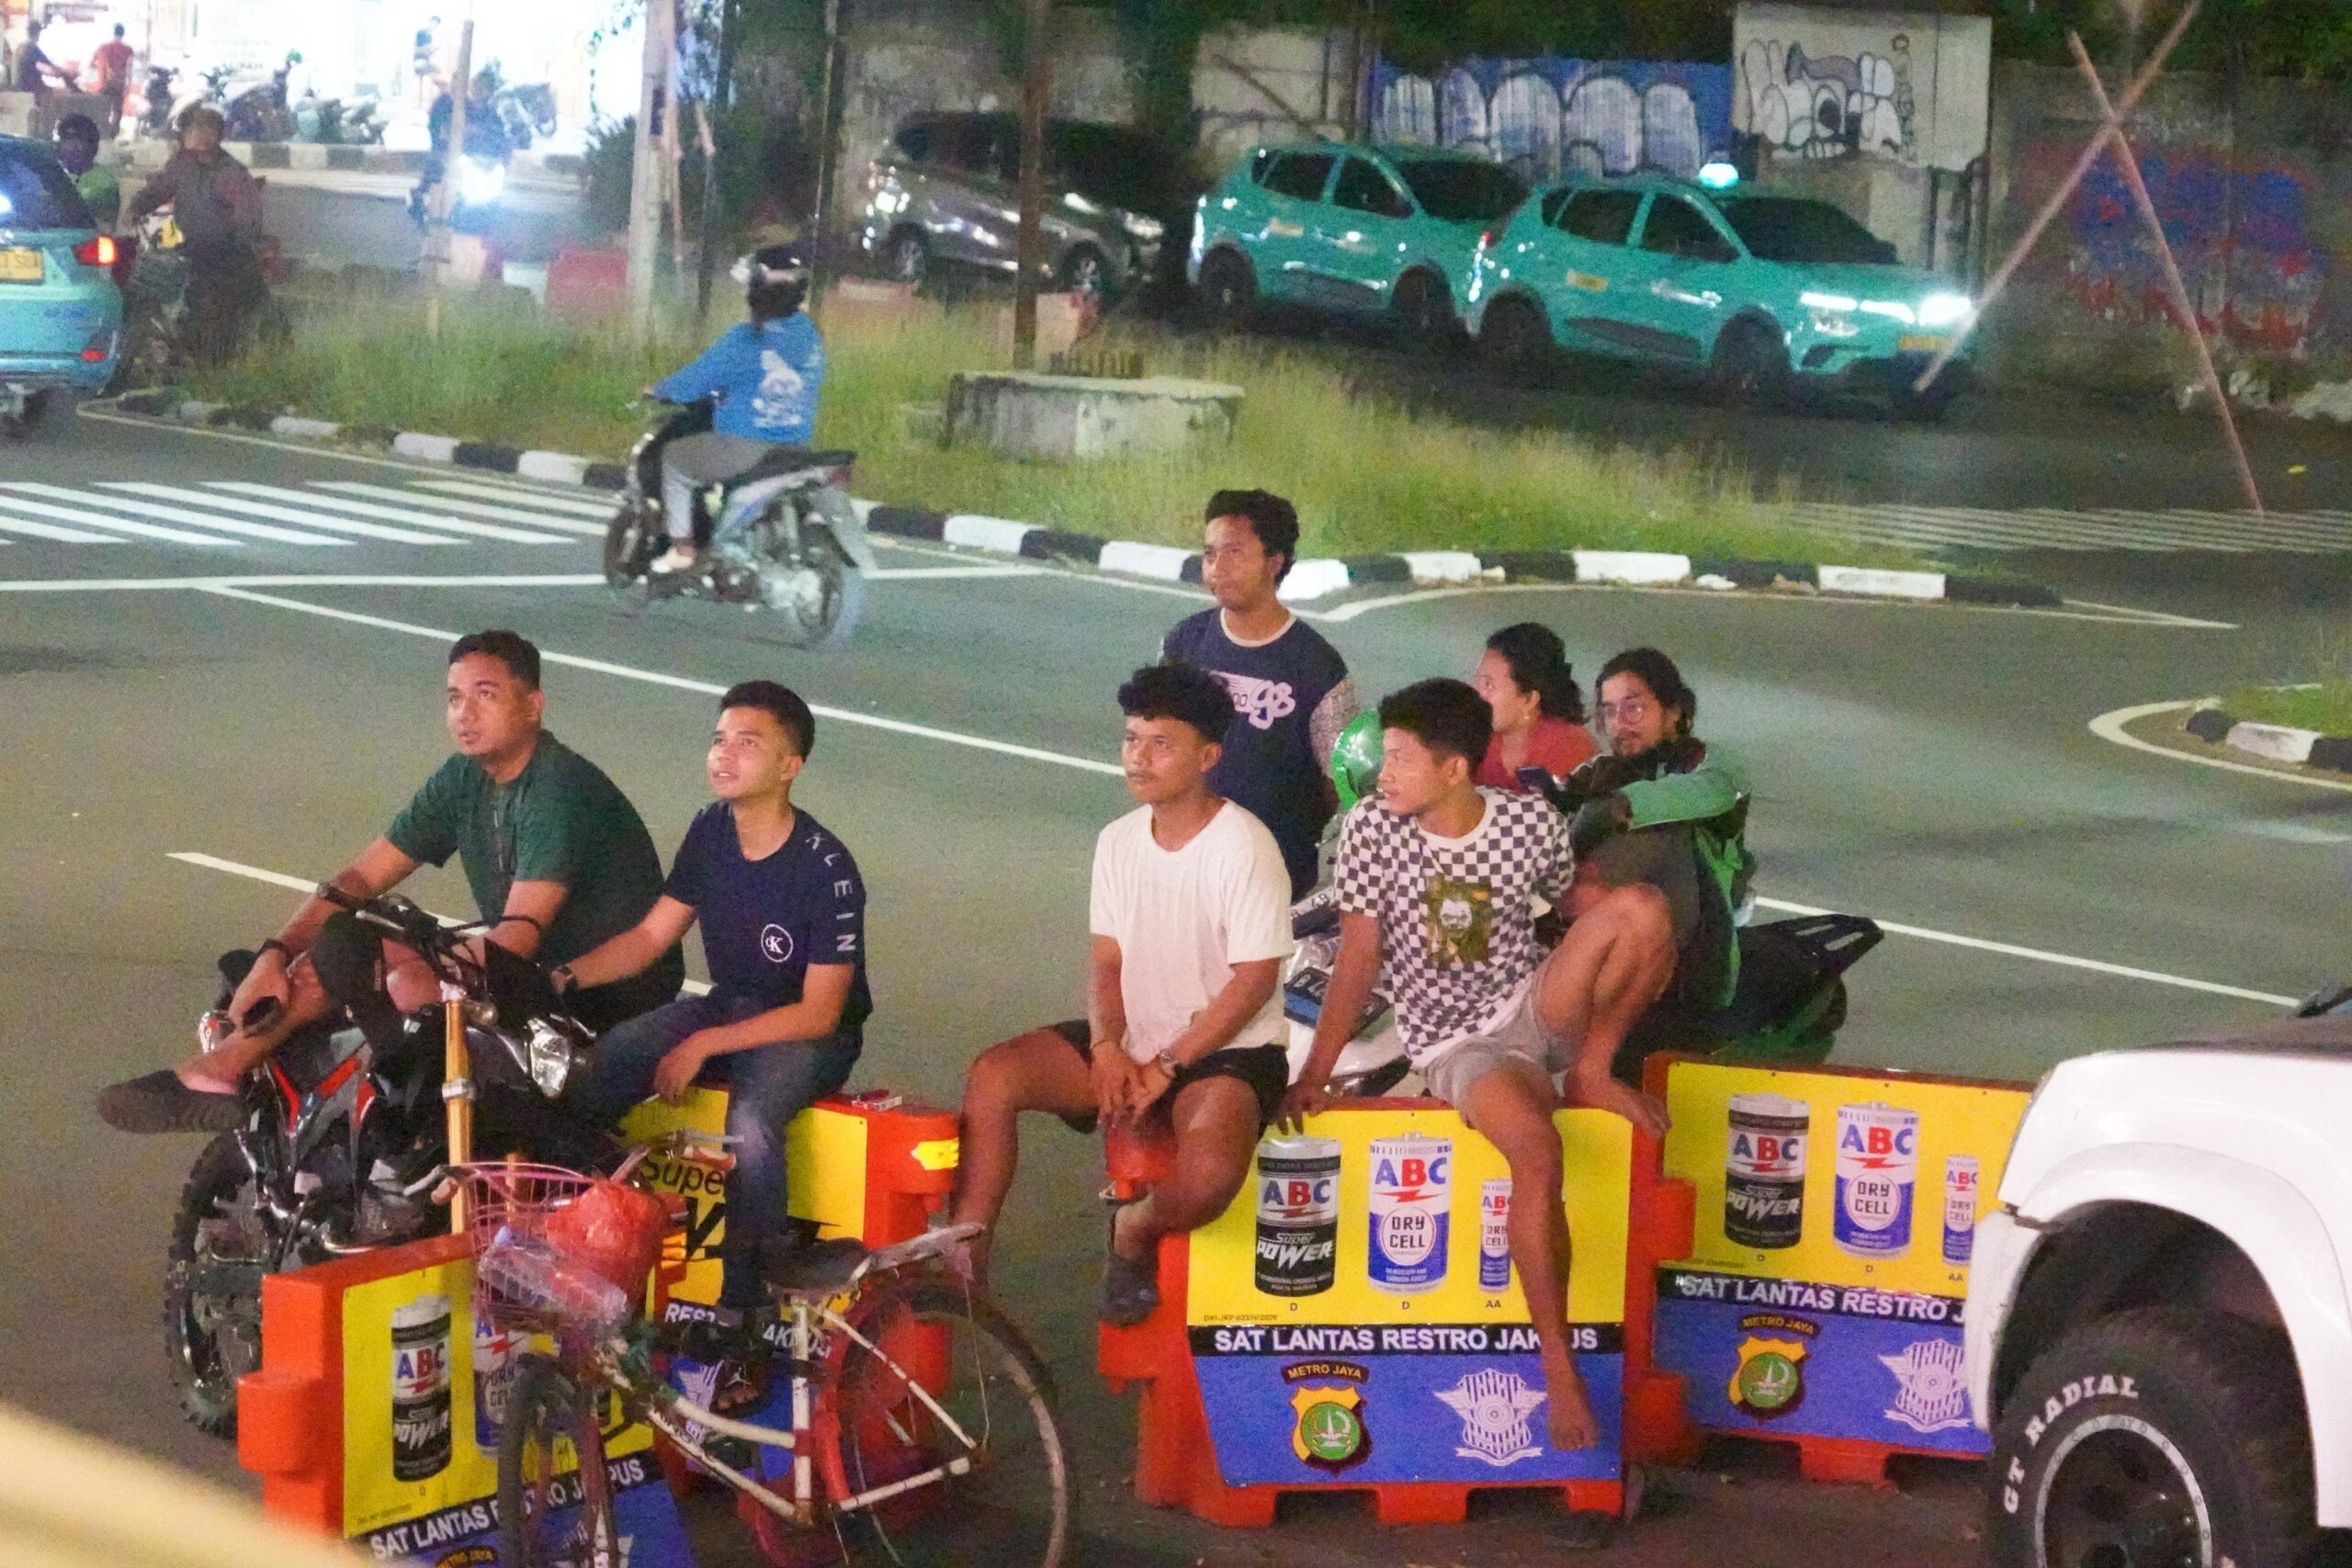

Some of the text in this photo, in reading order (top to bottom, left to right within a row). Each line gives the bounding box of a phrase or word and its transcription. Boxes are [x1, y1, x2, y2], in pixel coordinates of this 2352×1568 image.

[1733, 1134, 1799, 1161] ABC
[1840, 1123, 1914, 1156] ABC
[1374, 1156, 1448, 1188] ABC
[1263, 1179, 1331, 1206] ABC
[1857, 1181, 1891, 1198] DRY
[1726, 1191, 1802, 1223] POWER
[1854, 1198, 1891, 1215] CELL
[1391, 1216, 1426, 1231] DRY
[1389, 1234, 1427, 1249] CELL
[1256, 1240, 1335, 1270] POWER
[1948, 1273, 1963, 1281] AA
[1290, 1303, 1298, 1312] D
[1402, 1301, 1411, 1310] D
[1486, 1300, 1502, 1309] AA
[1681, 1274, 1732, 1300] SAT
[1735, 1280, 1835, 1311] LANTAS
[1841, 1289, 1948, 1323] RESTRO
[1742, 1314, 1815, 1336] METRO JAYA
[1214, 1329, 1265, 1351] SAT
[1272, 1329, 1374, 1351] LANTAS
[1382, 1328, 1487, 1350] RESTRO
[396, 1342, 446, 1381] ABC
[1287, 1364, 1362, 1380] METRO JAYA
[2003, 1374, 2139, 1514] GT RADIAL
[370, 1526, 410, 1560] SAT
[413, 1505, 490, 1548] LANTAS
